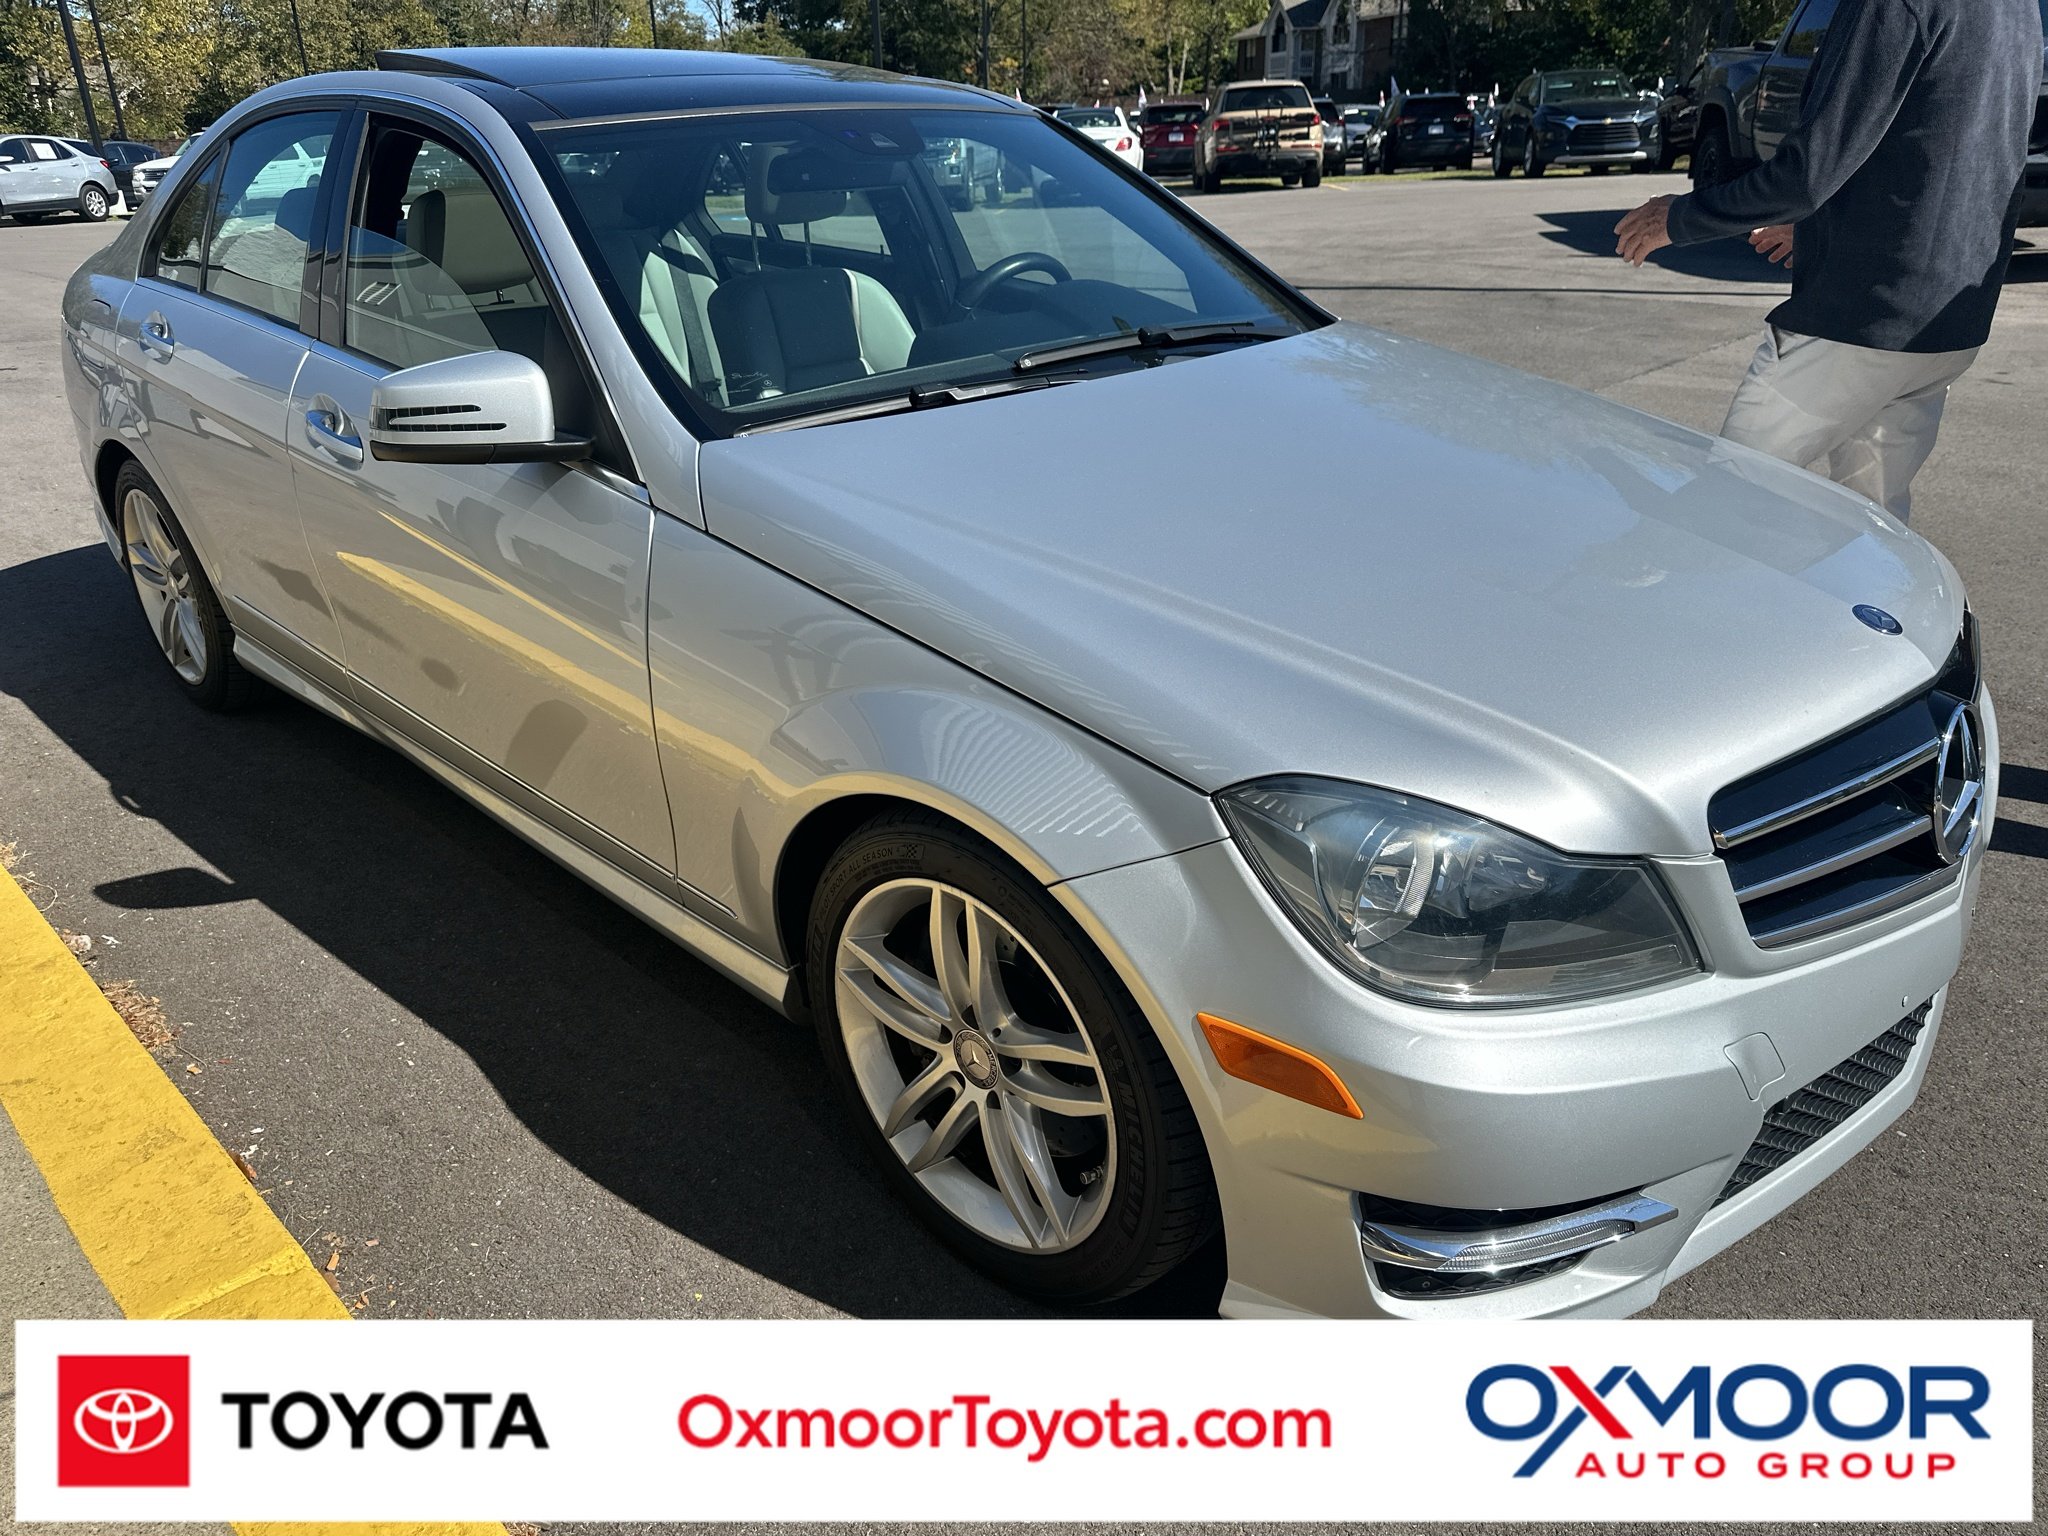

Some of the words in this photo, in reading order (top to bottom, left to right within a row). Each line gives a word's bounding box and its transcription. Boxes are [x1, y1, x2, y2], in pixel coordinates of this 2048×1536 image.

[830, 871, 847, 897] SPORT
[848, 859, 861, 873] ALL
[862, 847, 893, 864] SEASON
[1118, 1079, 1145, 1233] MICHELIN
